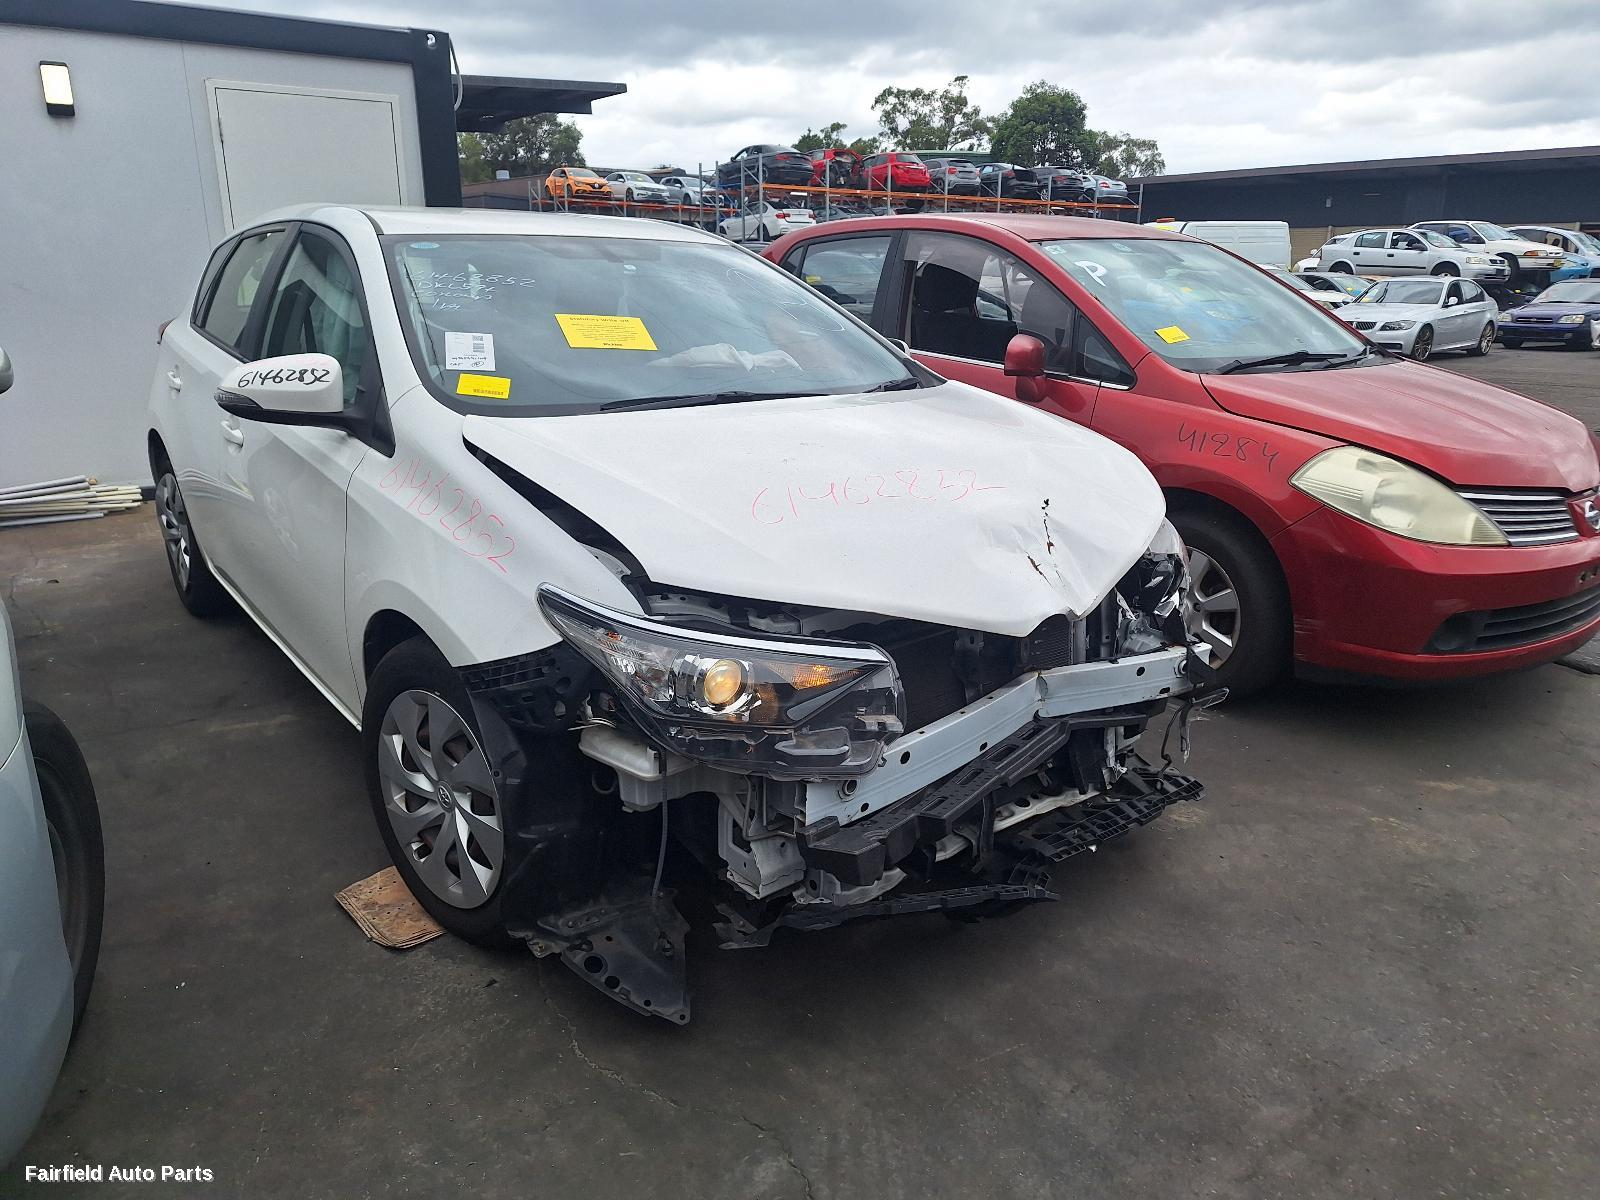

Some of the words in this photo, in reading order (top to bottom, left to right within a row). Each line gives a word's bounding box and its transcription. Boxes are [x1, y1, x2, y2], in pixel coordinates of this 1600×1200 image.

[238, 368, 331, 388] 61462852
[1178, 421, 1280, 472] 41284
[379, 456, 516, 574] 61462852
[751, 468, 1008, 525] 61462852
